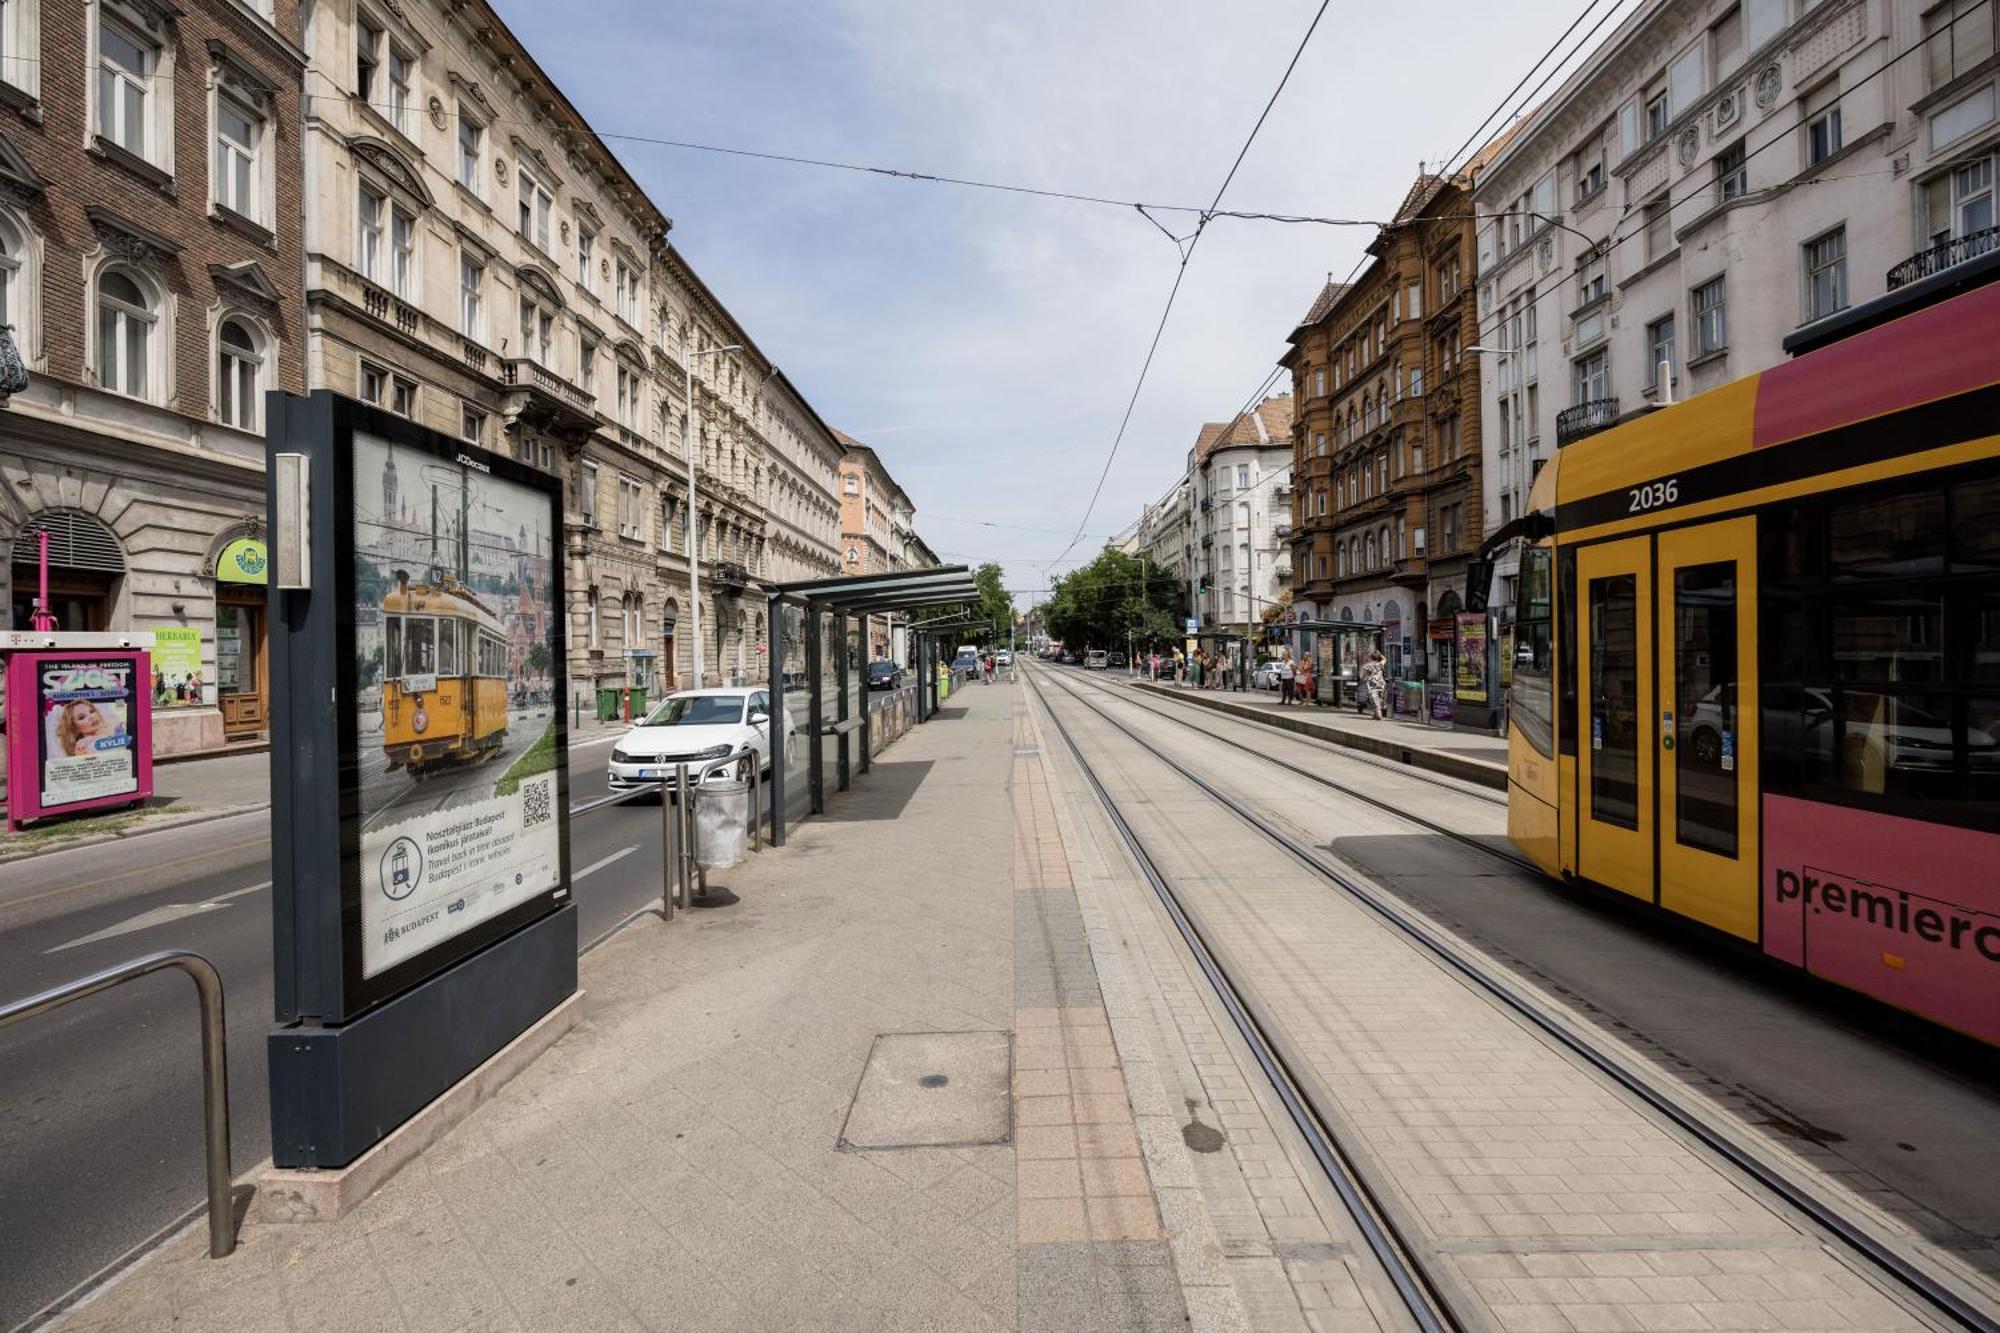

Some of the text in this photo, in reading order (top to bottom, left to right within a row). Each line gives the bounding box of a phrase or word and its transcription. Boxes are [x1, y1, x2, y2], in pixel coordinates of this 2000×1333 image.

[456, 453, 490, 474] JCDecaux
[1629, 479, 1678, 512] 2036
[42, 668, 131, 696] SZIGET
[100, 739, 126, 749] KYLIE
[474, 811, 505, 826] Budapest
[428, 854, 450, 870] Travel
[451, 848, 467, 862] back
[401, 911, 440, 935] BUDAPEST
